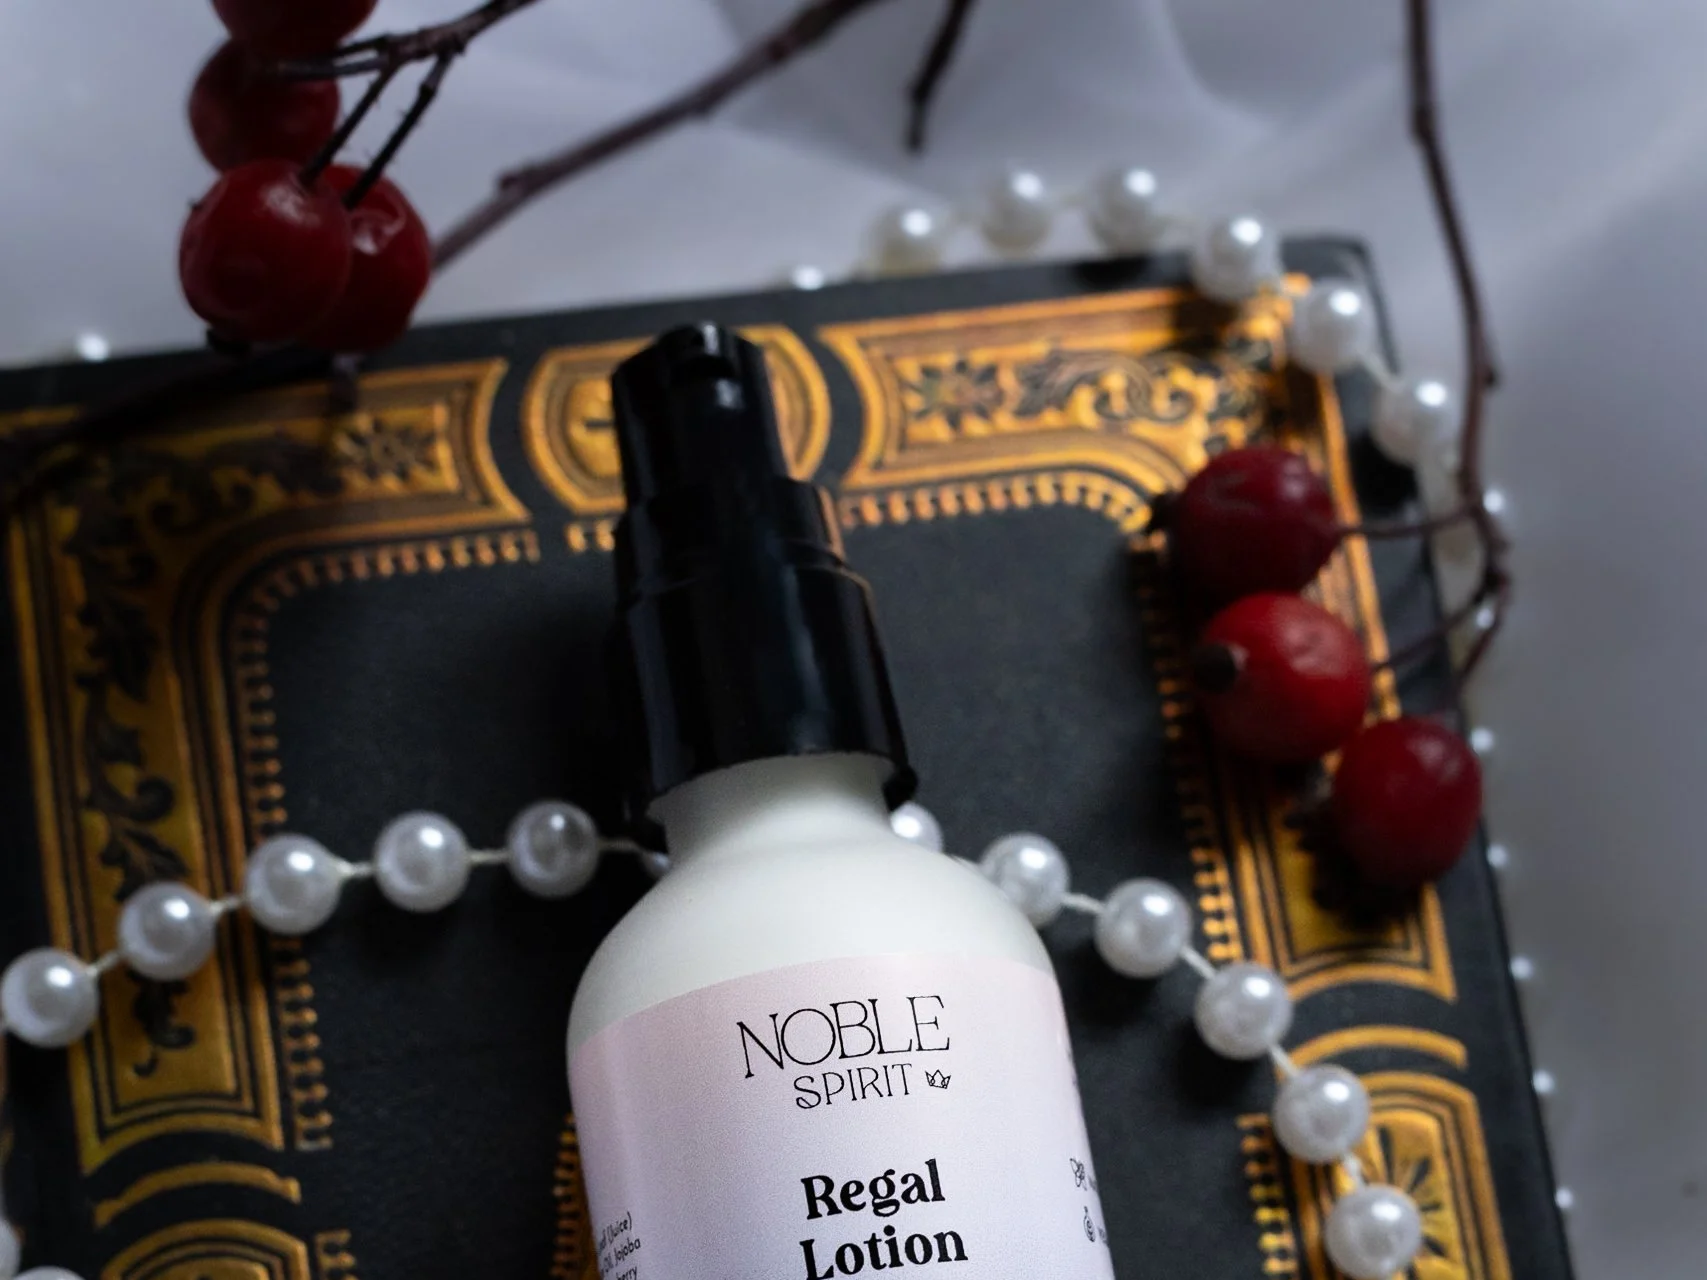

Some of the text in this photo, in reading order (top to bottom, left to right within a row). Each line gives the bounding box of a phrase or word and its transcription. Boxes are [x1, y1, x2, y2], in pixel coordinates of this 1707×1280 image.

[736, 995, 951, 1079] NOBLE
[793, 1063, 913, 1110] SPIRIT
[800, 1158, 946, 1220] Regal
[614, 1237, 641, 1267] Jojoba
